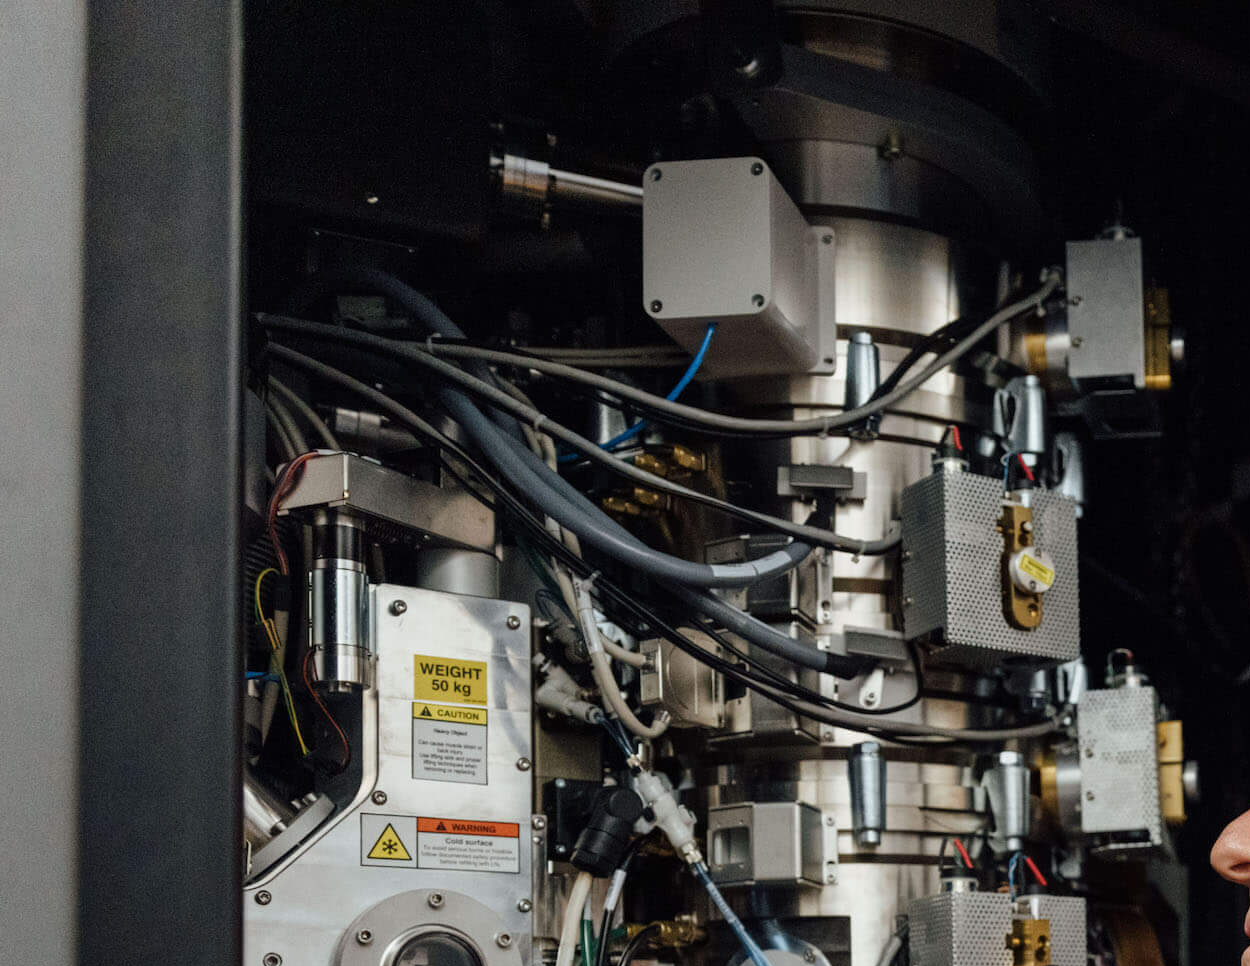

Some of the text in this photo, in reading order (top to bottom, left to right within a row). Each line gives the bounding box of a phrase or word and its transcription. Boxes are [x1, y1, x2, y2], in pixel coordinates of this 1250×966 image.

[419, 662, 482, 680] WEIGHT
[431, 679, 471, 697] 50 kg
[437, 709, 480, 721] CAUTION
[451, 823, 496, 834] WARNING
